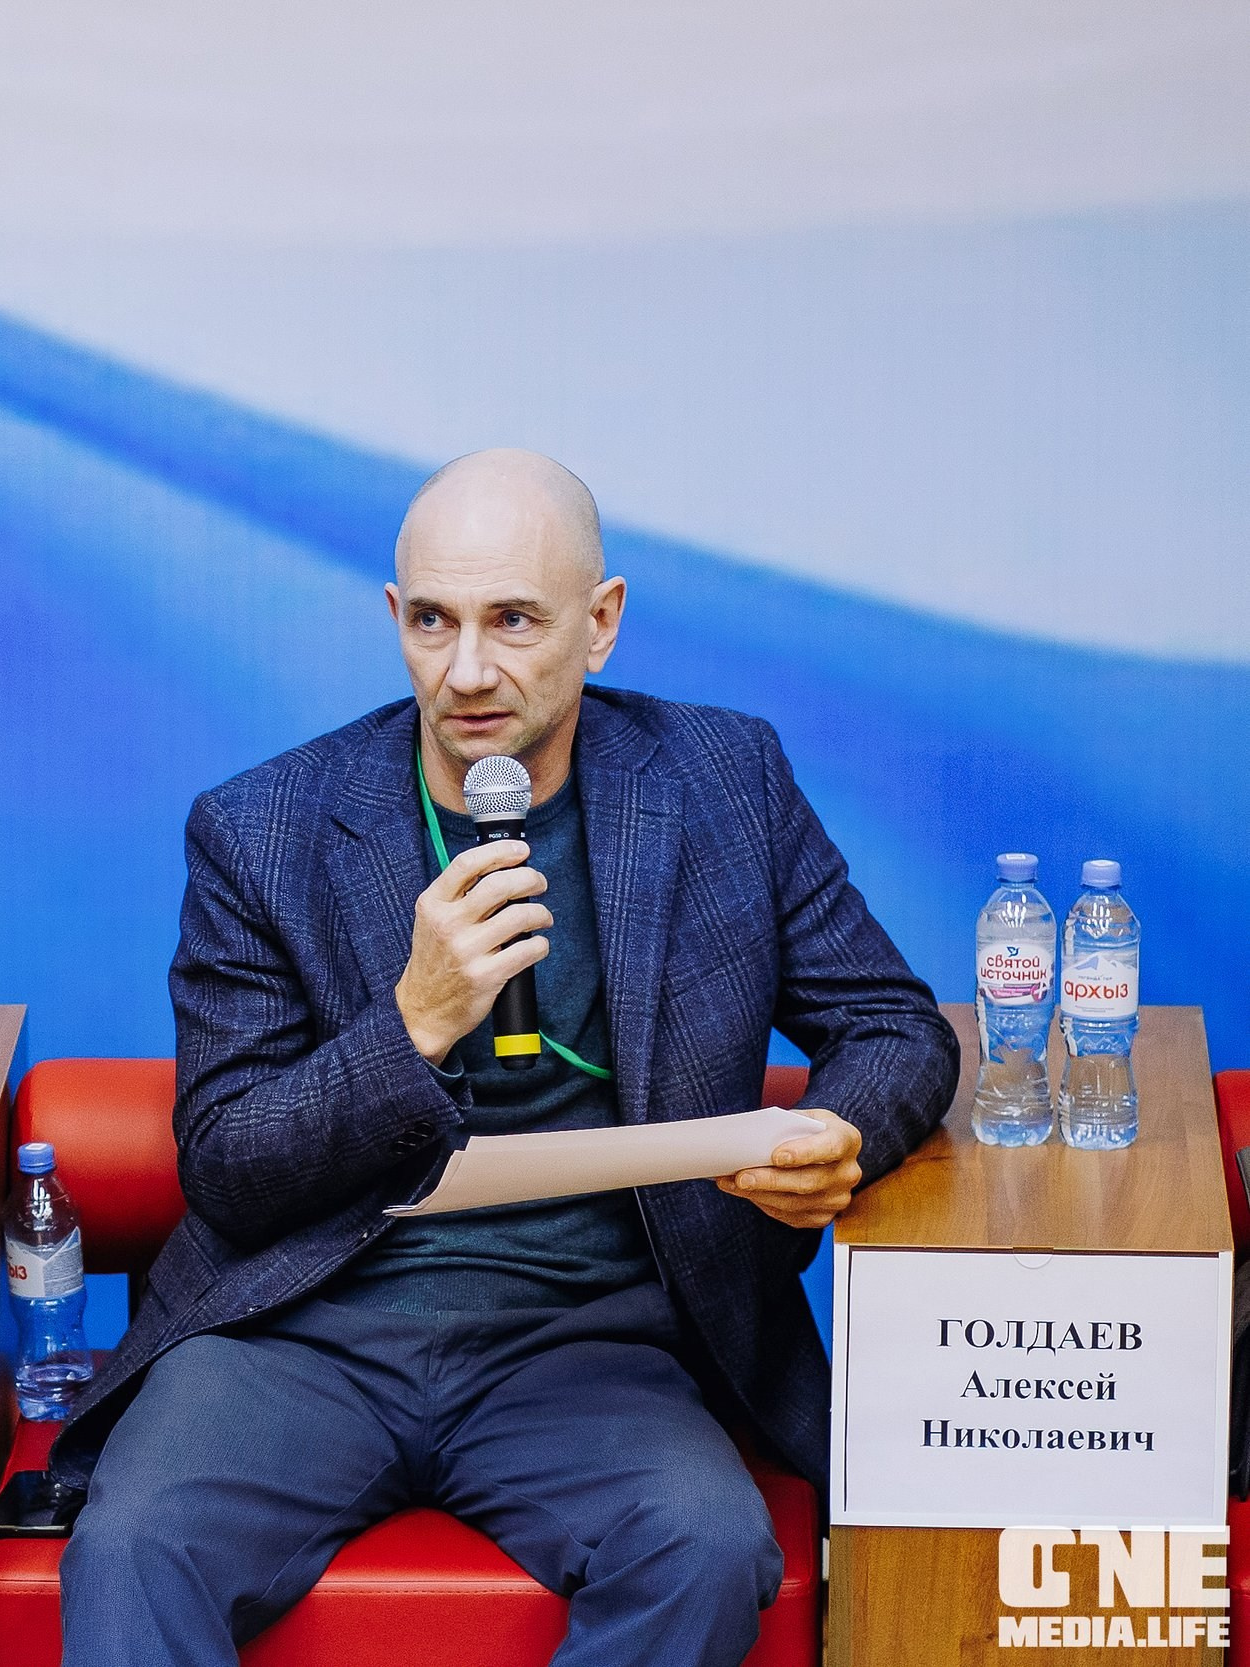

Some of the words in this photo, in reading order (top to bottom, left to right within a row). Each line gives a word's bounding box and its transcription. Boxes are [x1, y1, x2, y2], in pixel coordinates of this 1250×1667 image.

[980, 967, 1047, 981] источник
[1064, 980, 1129, 1001] архыз
[937, 1318, 1143, 1356] ГОЛДАЕВ
[959, 1370, 1117, 1401] Алексей
[920, 1418, 1155, 1452] Николаевич
